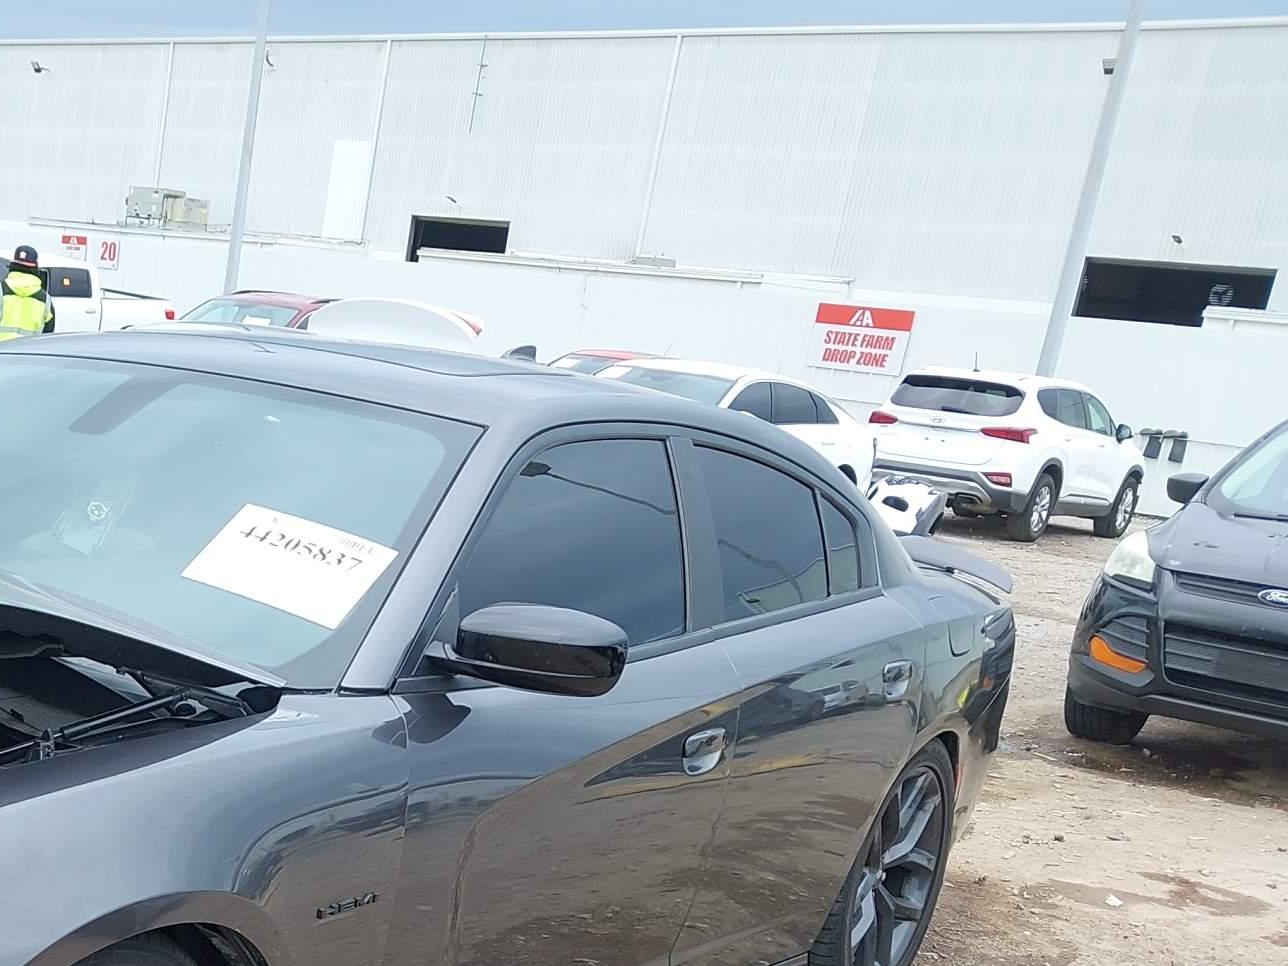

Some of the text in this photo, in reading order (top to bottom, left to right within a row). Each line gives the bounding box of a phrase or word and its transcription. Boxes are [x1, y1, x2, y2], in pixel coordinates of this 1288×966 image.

[100, 240, 117, 261] 20
[823, 330, 896, 351] STATE FARM
[822, 347, 889, 368] DROP ZONE
[239, 525, 364, 572] 44205837
